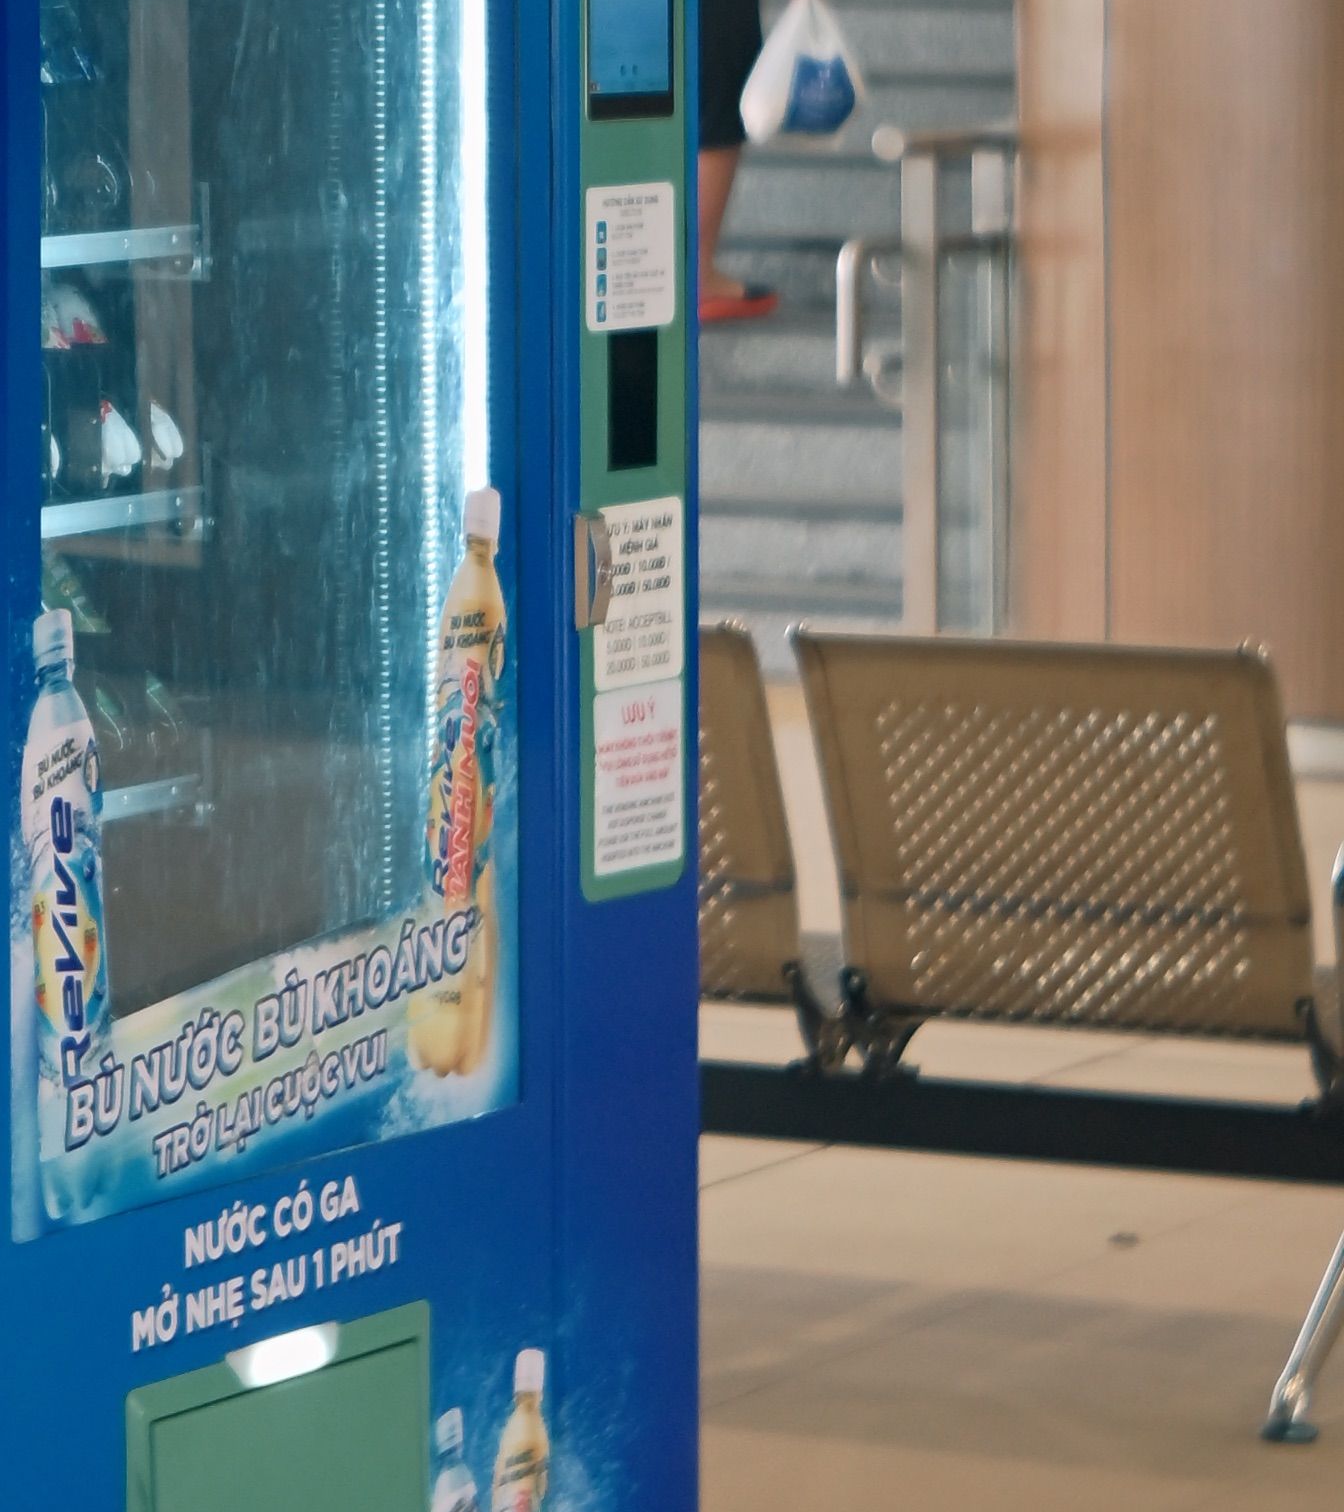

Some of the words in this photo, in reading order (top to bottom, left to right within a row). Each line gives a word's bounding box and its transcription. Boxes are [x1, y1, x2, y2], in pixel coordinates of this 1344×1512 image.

[64, 1051, 125, 1154] BÙ
[127, 1007, 246, 1122] NƯỚC
[253, 968, 308, 1063] BÙ
[310, 916, 470, 1036] KHOÁNG
[152, 1100, 215, 1179] TRỞ
[214, 1087, 264, 1156] LẠI
[263, 1051, 342, 1125] CUỘC
[338, 1028, 389, 1089] VUI
[130, 1282, 180, 1353] MỞ
[184, 1275, 246, 1335] NHẸ
[249, 1253, 308, 1311] SAU
[312, 1248, 325, 1290] 1
[329, 1218, 404, 1285] PHÚT
[183, 1199, 268, 1270] NƯỚC
[272, 1178, 314, 1239] CÓ
[319, 1175, 361, 1223] GA
